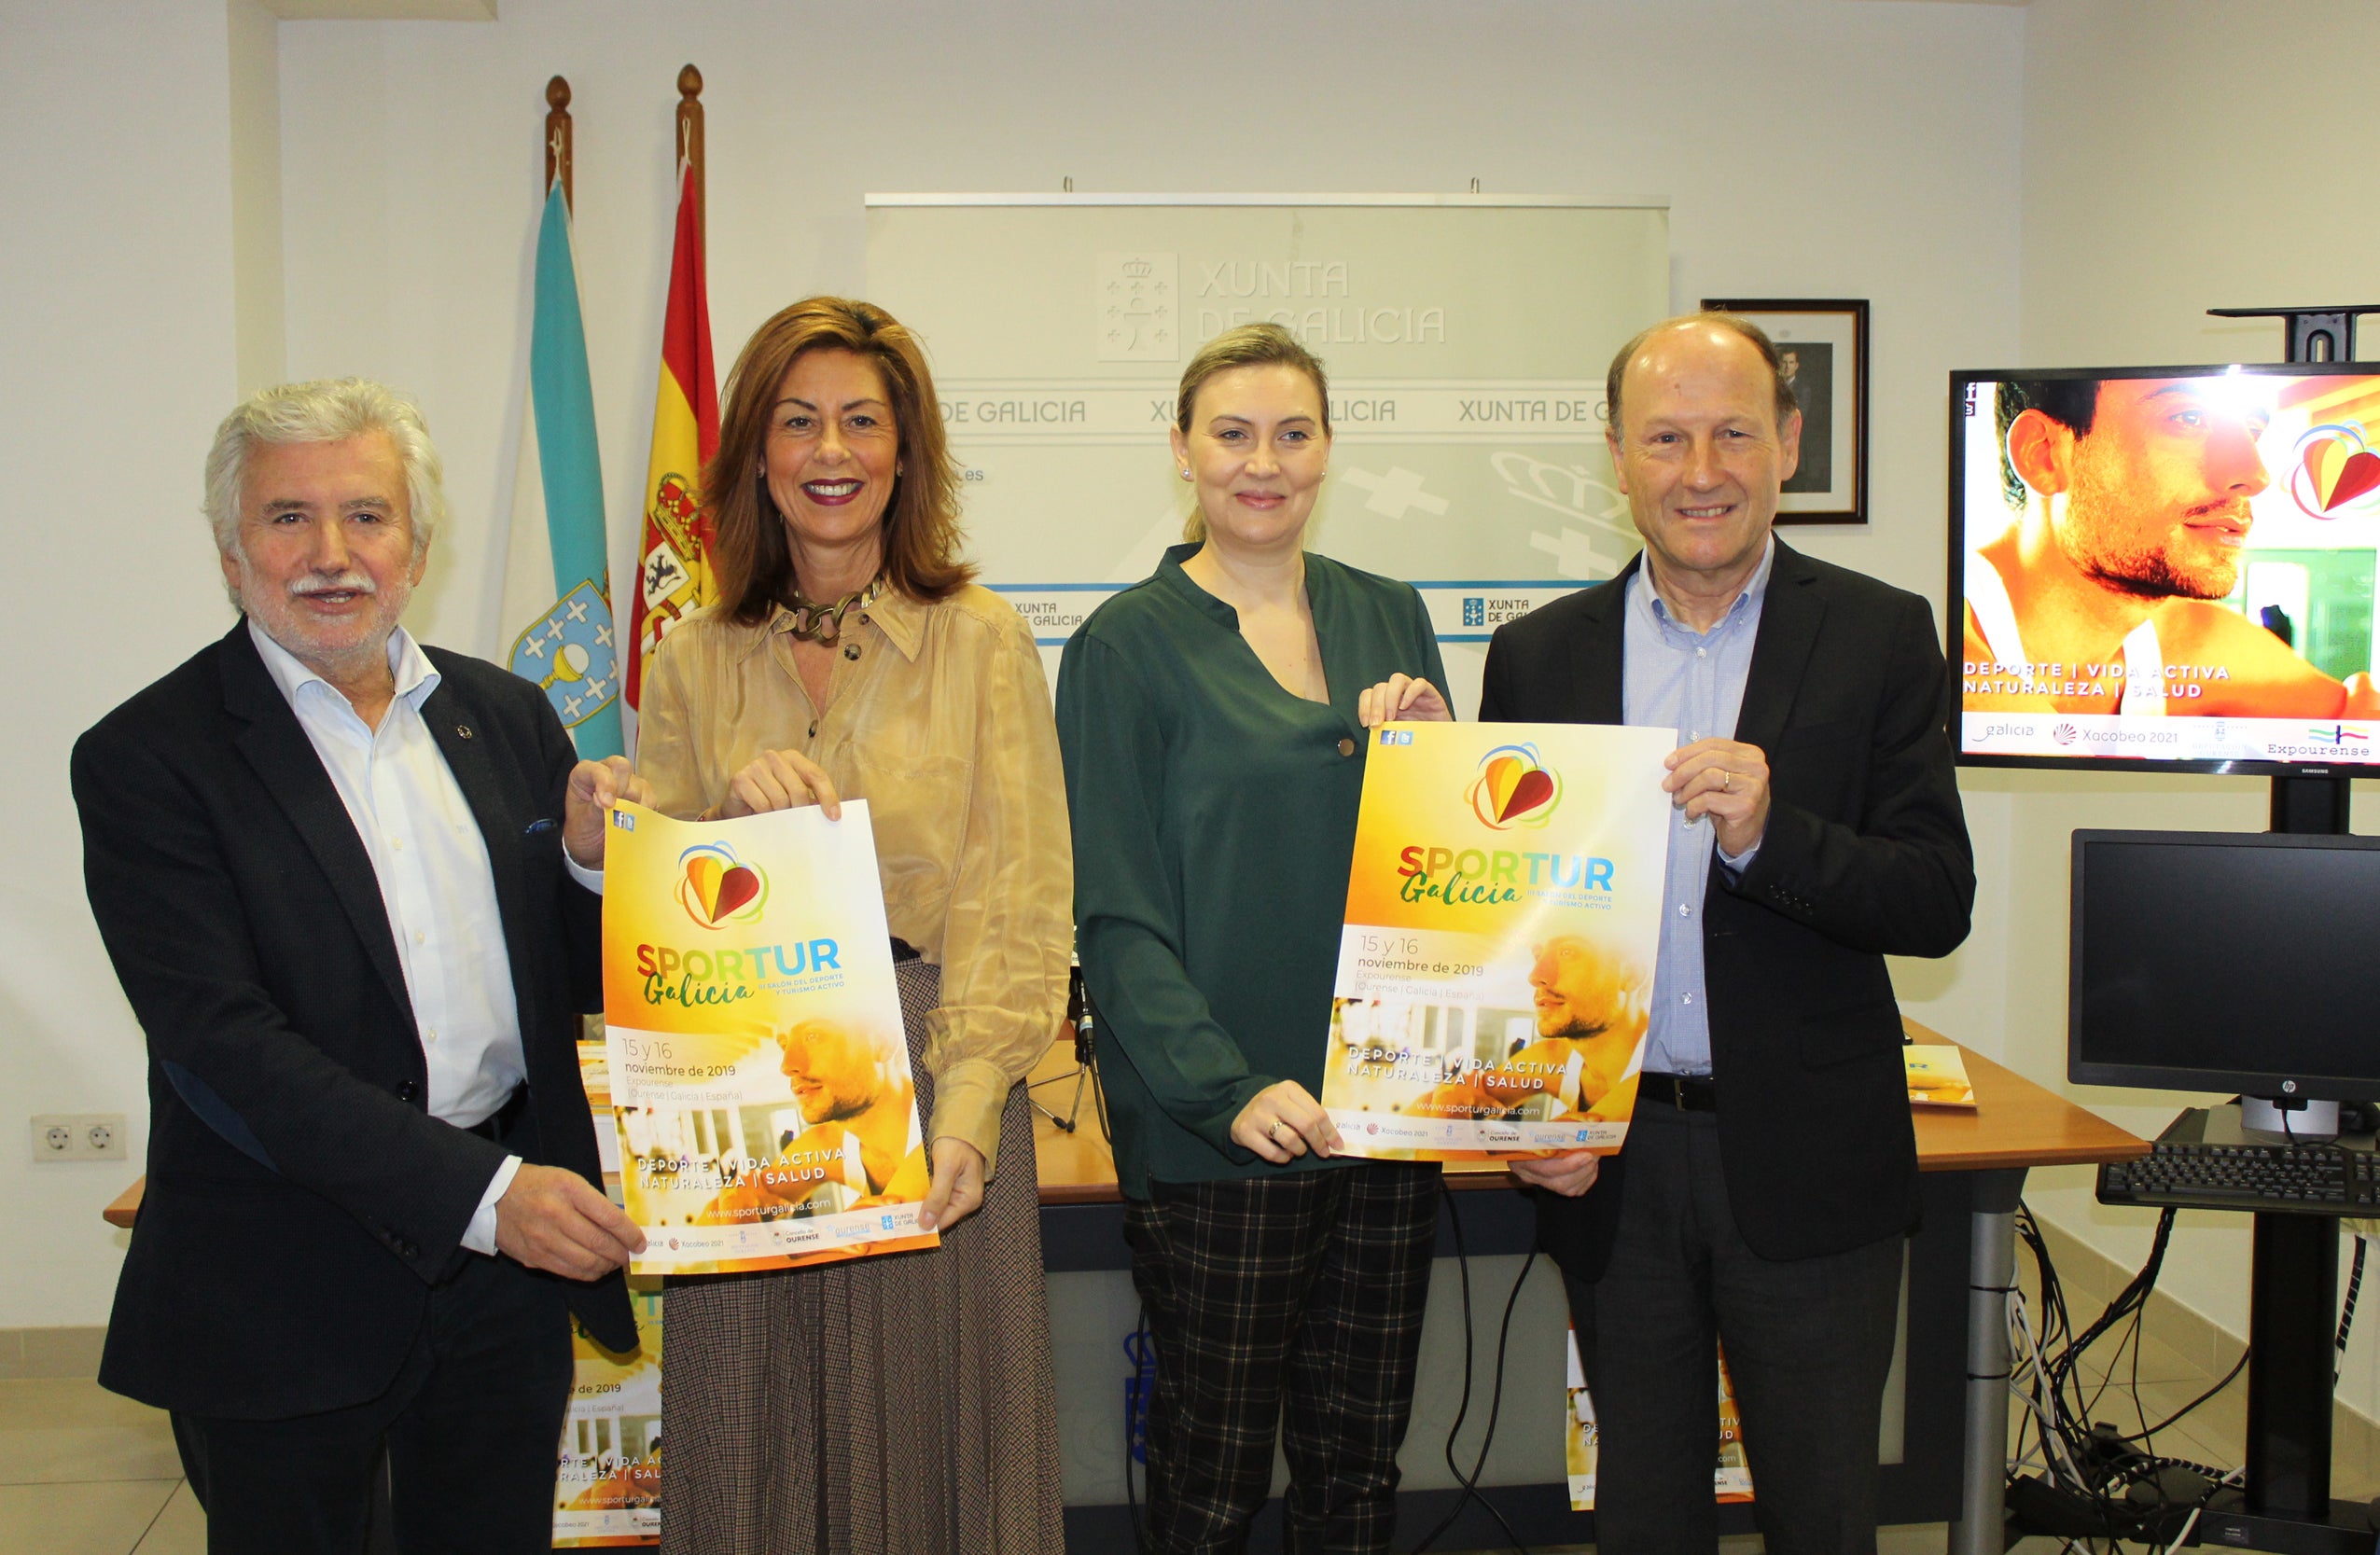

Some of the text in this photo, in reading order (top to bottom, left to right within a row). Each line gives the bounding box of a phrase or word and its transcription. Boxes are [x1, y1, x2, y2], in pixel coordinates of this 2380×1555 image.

[1195, 260, 1350, 298] XUNTA
[977, 401, 1086, 423] GALICIA
[1329, 400, 1397, 422] LICIA
[1459, 400, 1547, 422] XUNTA
[1555, 400, 1587, 422] DE
[1015, 603, 1057, 614] XUNTA
[1488, 599, 1529, 610] XUNTA
[1033, 615, 1082, 626] GALICIA
[1488, 612, 1503, 622] DE
[1963, 662, 2231, 680] DEPORTE VIDA ACTIVA
[1963, 680, 2203, 699] NATURALEZA SALUD
[1971, 723, 2035, 743] galicia
[2082, 729, 2178, 743] Xacobeo 2021
[2267, 743, 2371, 757] Expourense
[1397, 845, 1615, 893] SPORTUR
[1400, 870, 1523, 906] Galicia
[1579, 894, 1613, 903] DEPORTE
[1360, 935, 1419, 957] 15 y 16
[636, 937, 842, 981] SPORTUR
[1357, 957, 1484, 977] noviembre de 2019
[809, 973, 844, 983] DEPORTE
[1356, 969, 1413, 983] Expourense
[643, 971, 755, 1008] Galicia
[782, 985, 815, 995] TURISMO
[817, 981, 845, 991] ACTIVO
[1405, 985, 1438, 997] Galicia
[622, 1038, 673, 1062] 15 y 16
[1348, 1047, 1568, 1076] DEPORTE VIDA ACTIVA
[625, 1062, 736, 1077] noviembre de 2019
[1347, 1064, 1545, 1090] NATURALEZA SALUD
[626, 1076, 674, 1089] Expourense
[671, 1090, 699, 1101] Galicia
[1416, 1101, 1541, 1116] www.sporturgalicia.com
[1381, 1127, 1413, 1137] Xacobeo
[637, 1148, 847, 1173] DEPORTE VIDA ACTIVA
[640, 1167, 827, 1191] NATURALEZA SALUD
[705, 1198, 831, 1219] www.sporturgalicia.com
[681, 1239, 724, 1248] Xacobeo 2021
[786, 1232, 820, 1243] OURENSE
[578, 1383, 621, 1394] de 2019
[605, 1456, 641, 1467] VIDA
[560, 1469, 661, 1482] RALEZA SAL
